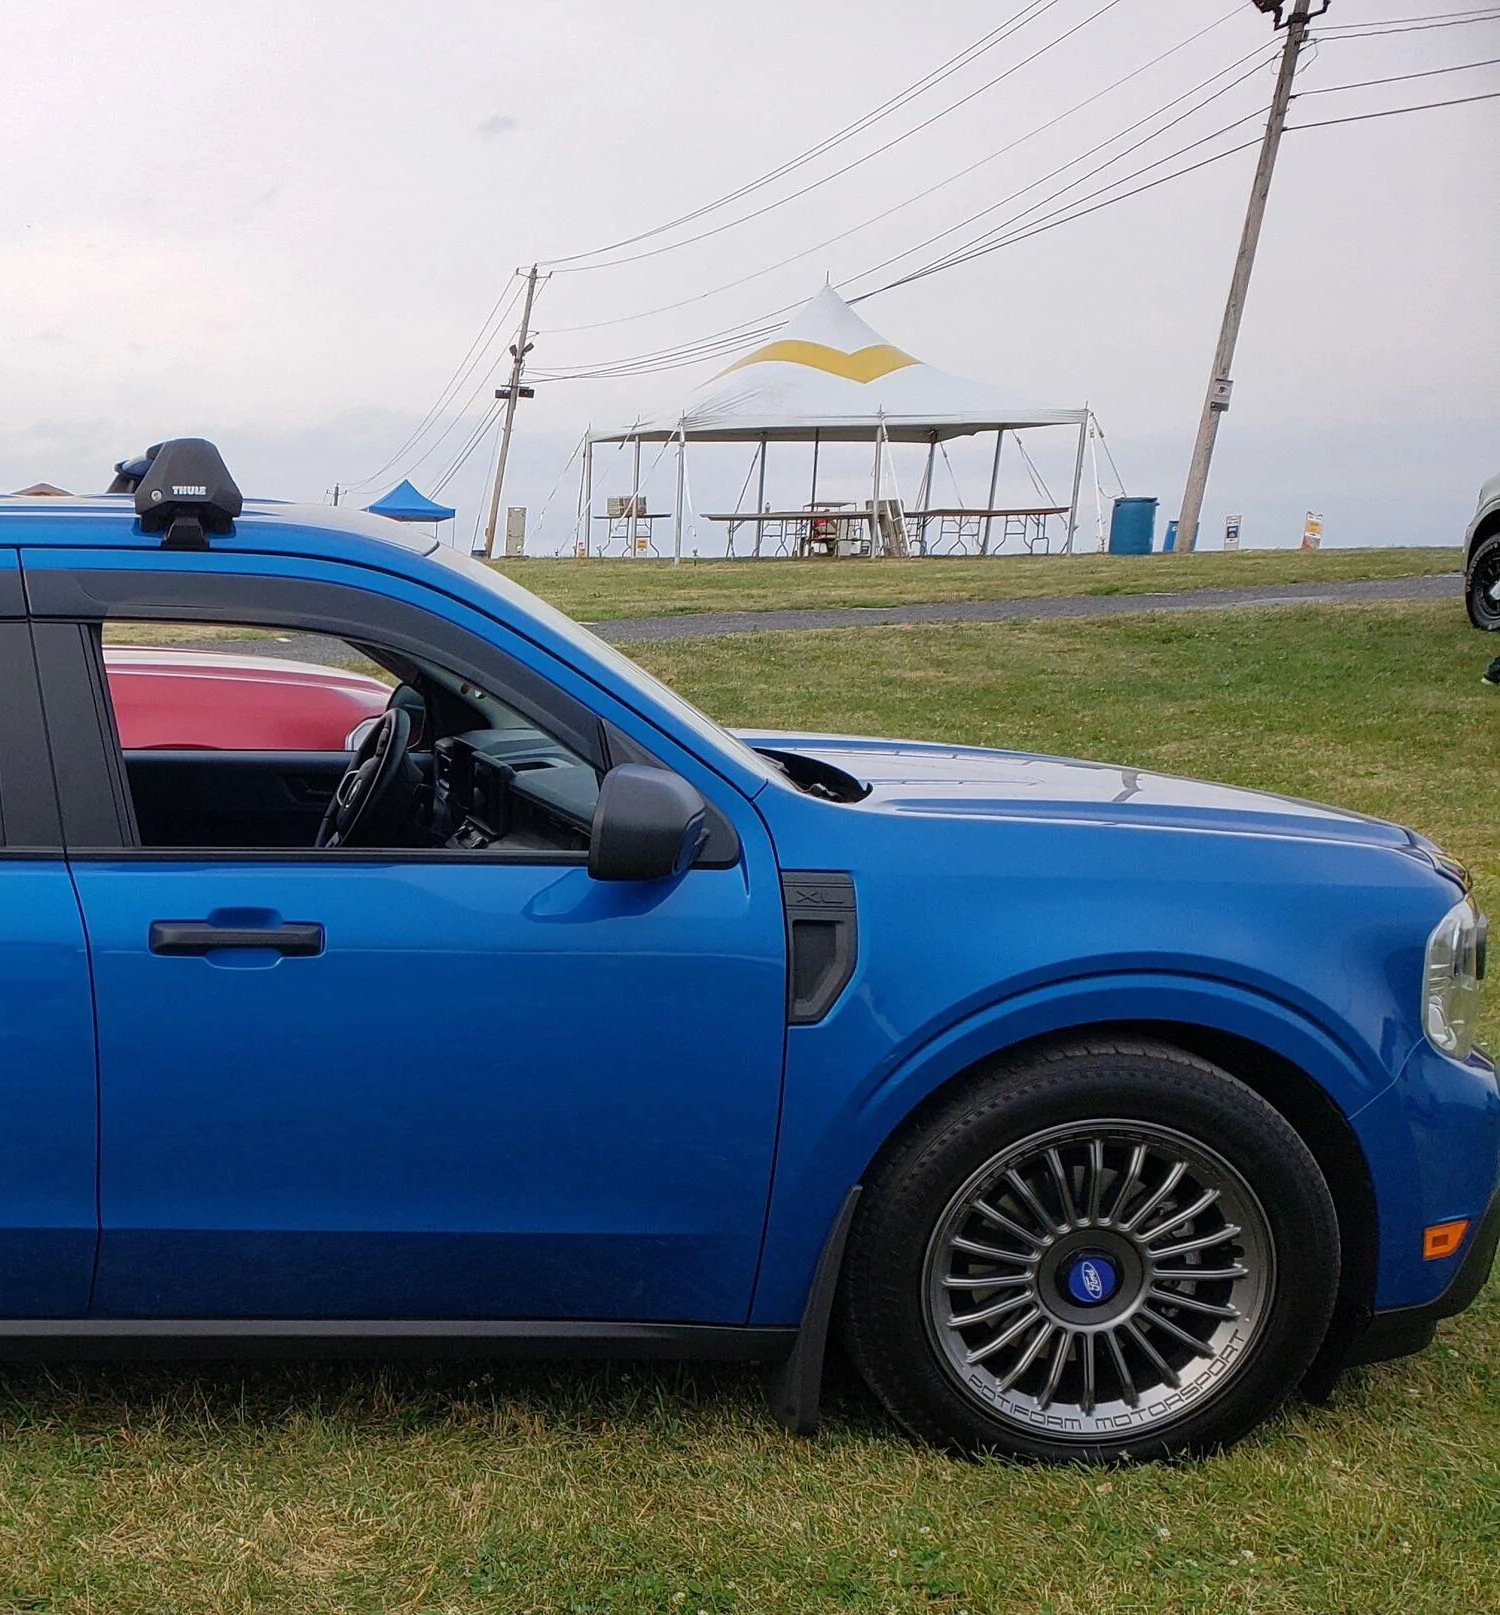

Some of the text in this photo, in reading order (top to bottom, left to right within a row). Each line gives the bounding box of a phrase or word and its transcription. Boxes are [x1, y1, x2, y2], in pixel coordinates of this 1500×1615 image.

[172, 485, 206, 496] THULE
[796, 890, 844, 904] XL
[1083, 1267, 1100, 1292] Ford
[968, 1328, 1245, 1431] ROTIFORM MOTORSPORT
